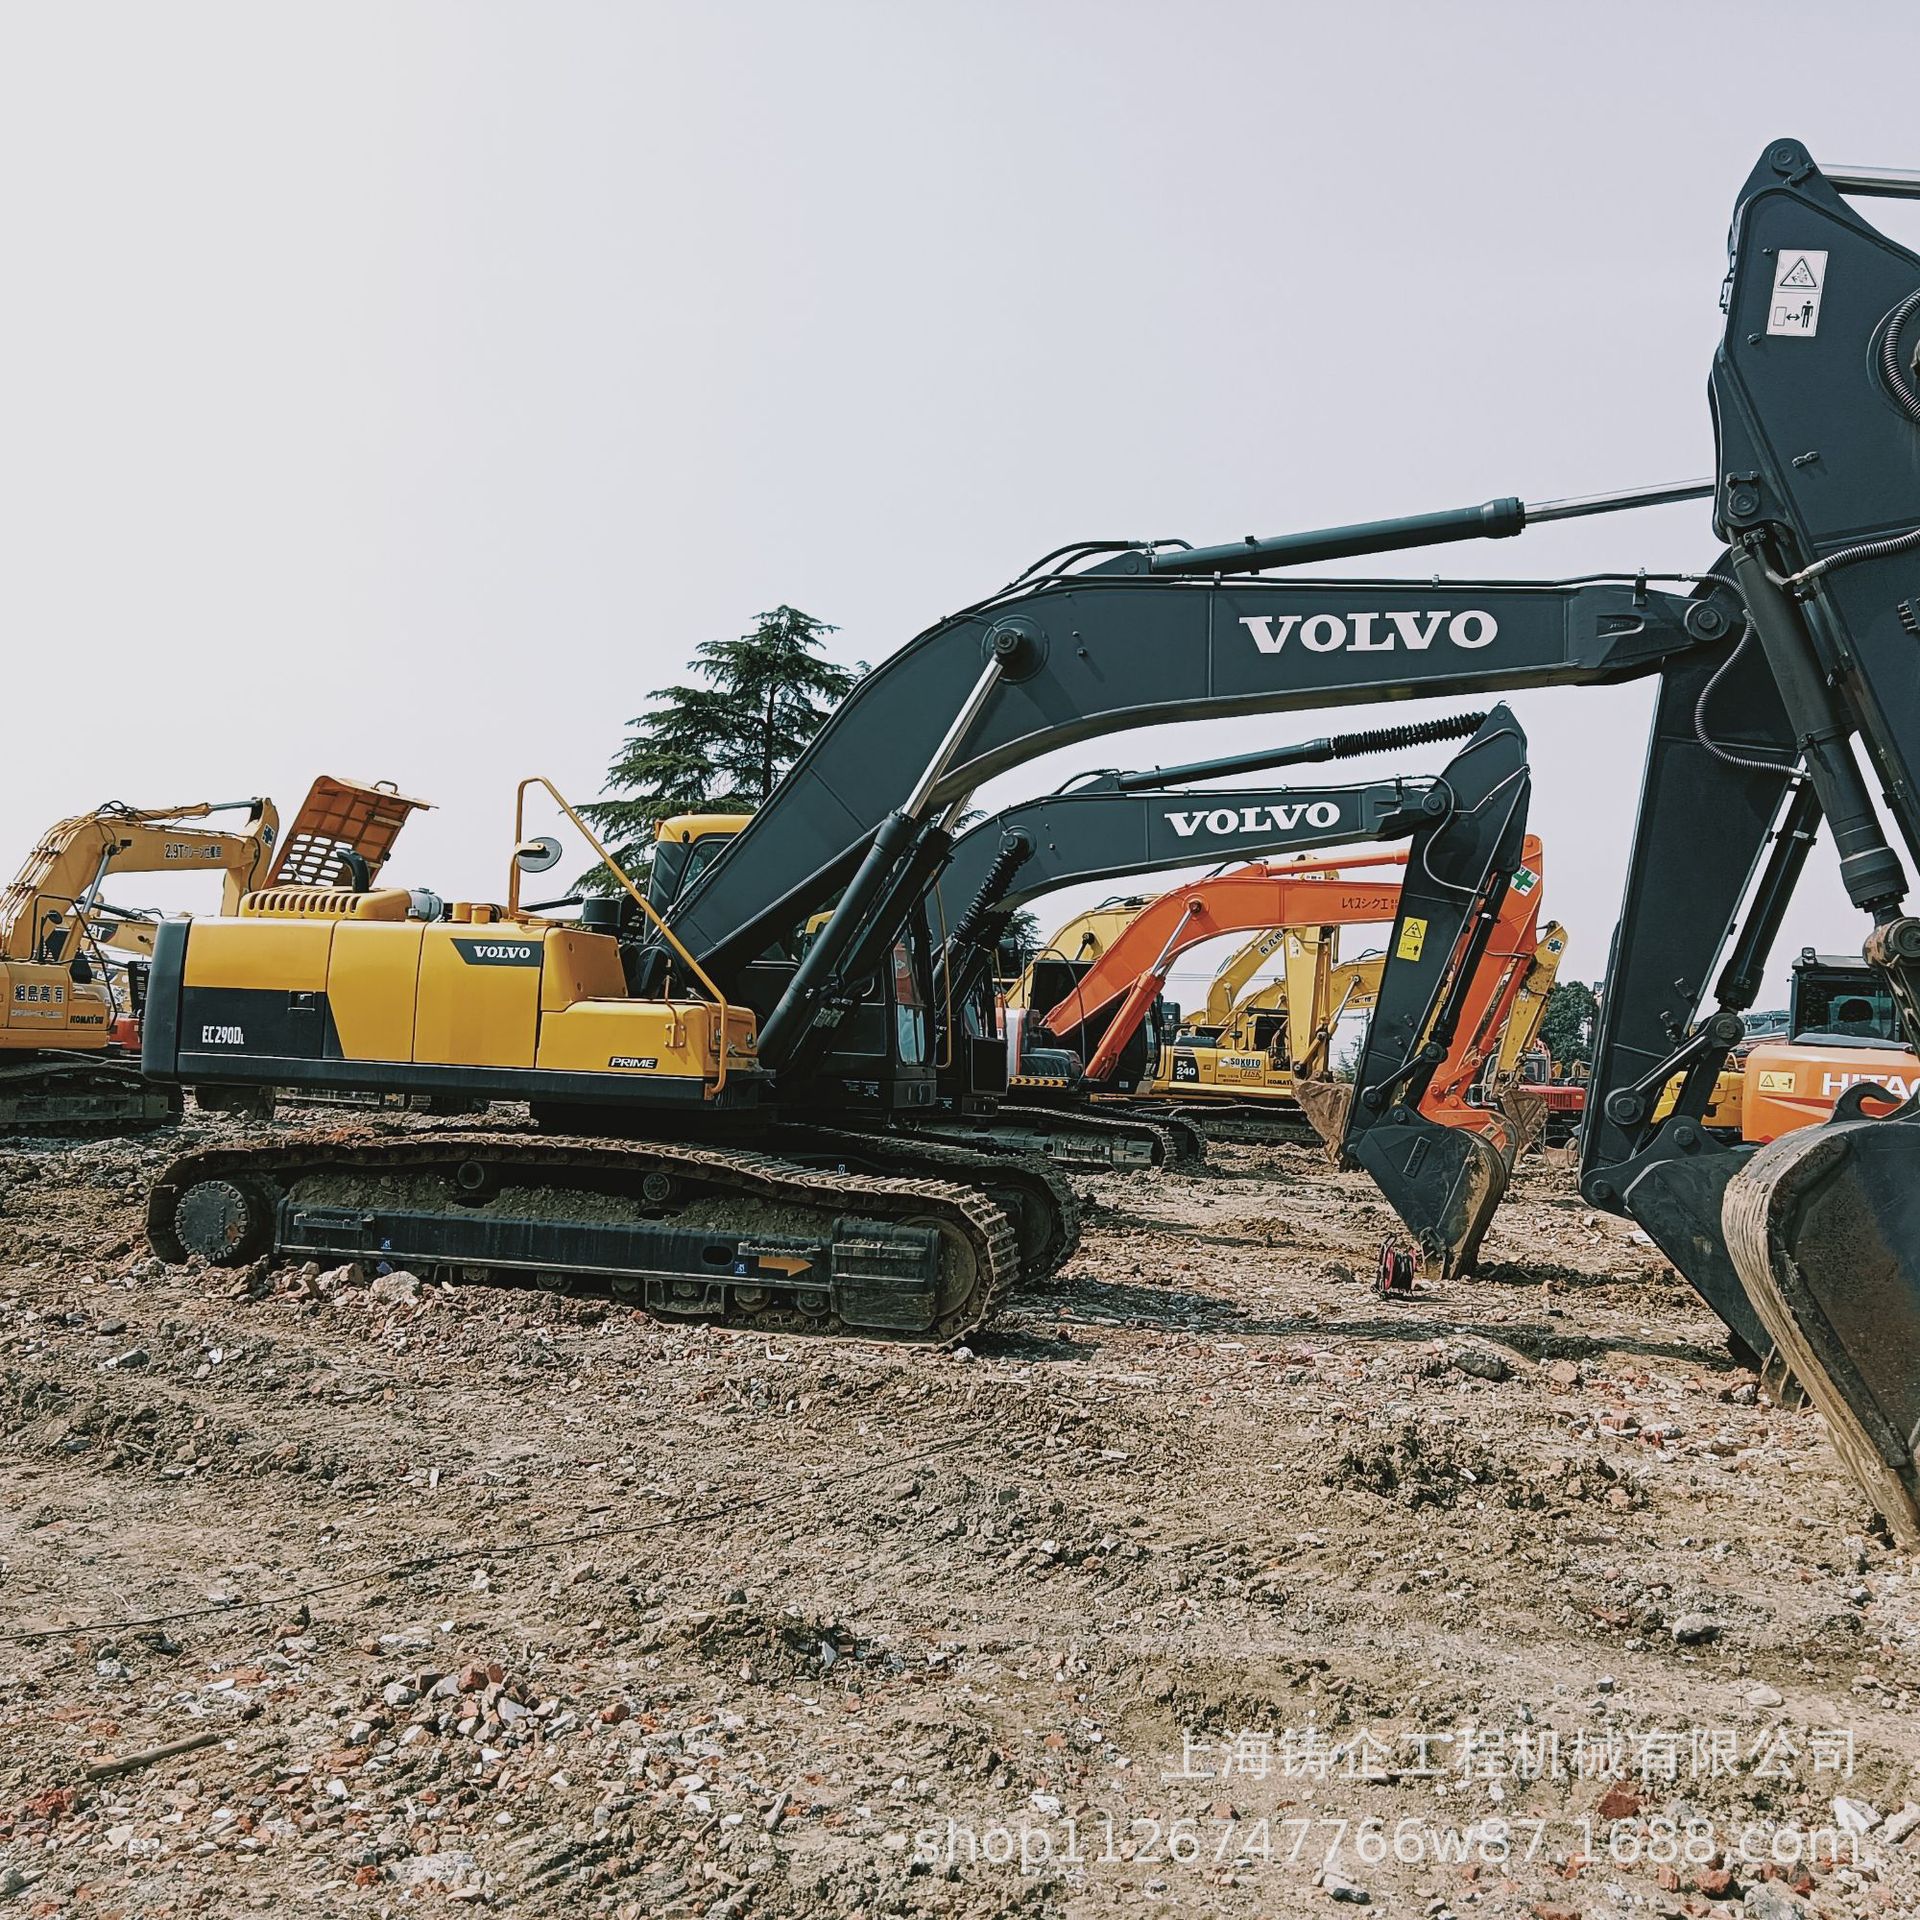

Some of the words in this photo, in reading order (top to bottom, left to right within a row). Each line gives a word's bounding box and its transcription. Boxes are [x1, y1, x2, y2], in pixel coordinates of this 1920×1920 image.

[1239, 610, 1498, 653] VOLVO
[1164, 801, 1341, 837] VOLVO
[473, 945, 531, 959] VOLVO
[69, 1014, 104, 1025] KOMATSU
[611, 1057, 656, 1068] PRIME
[1230, 1057, 1261, 1068] SOKUTO
[1176, 1067, 1196, 1076] 240
